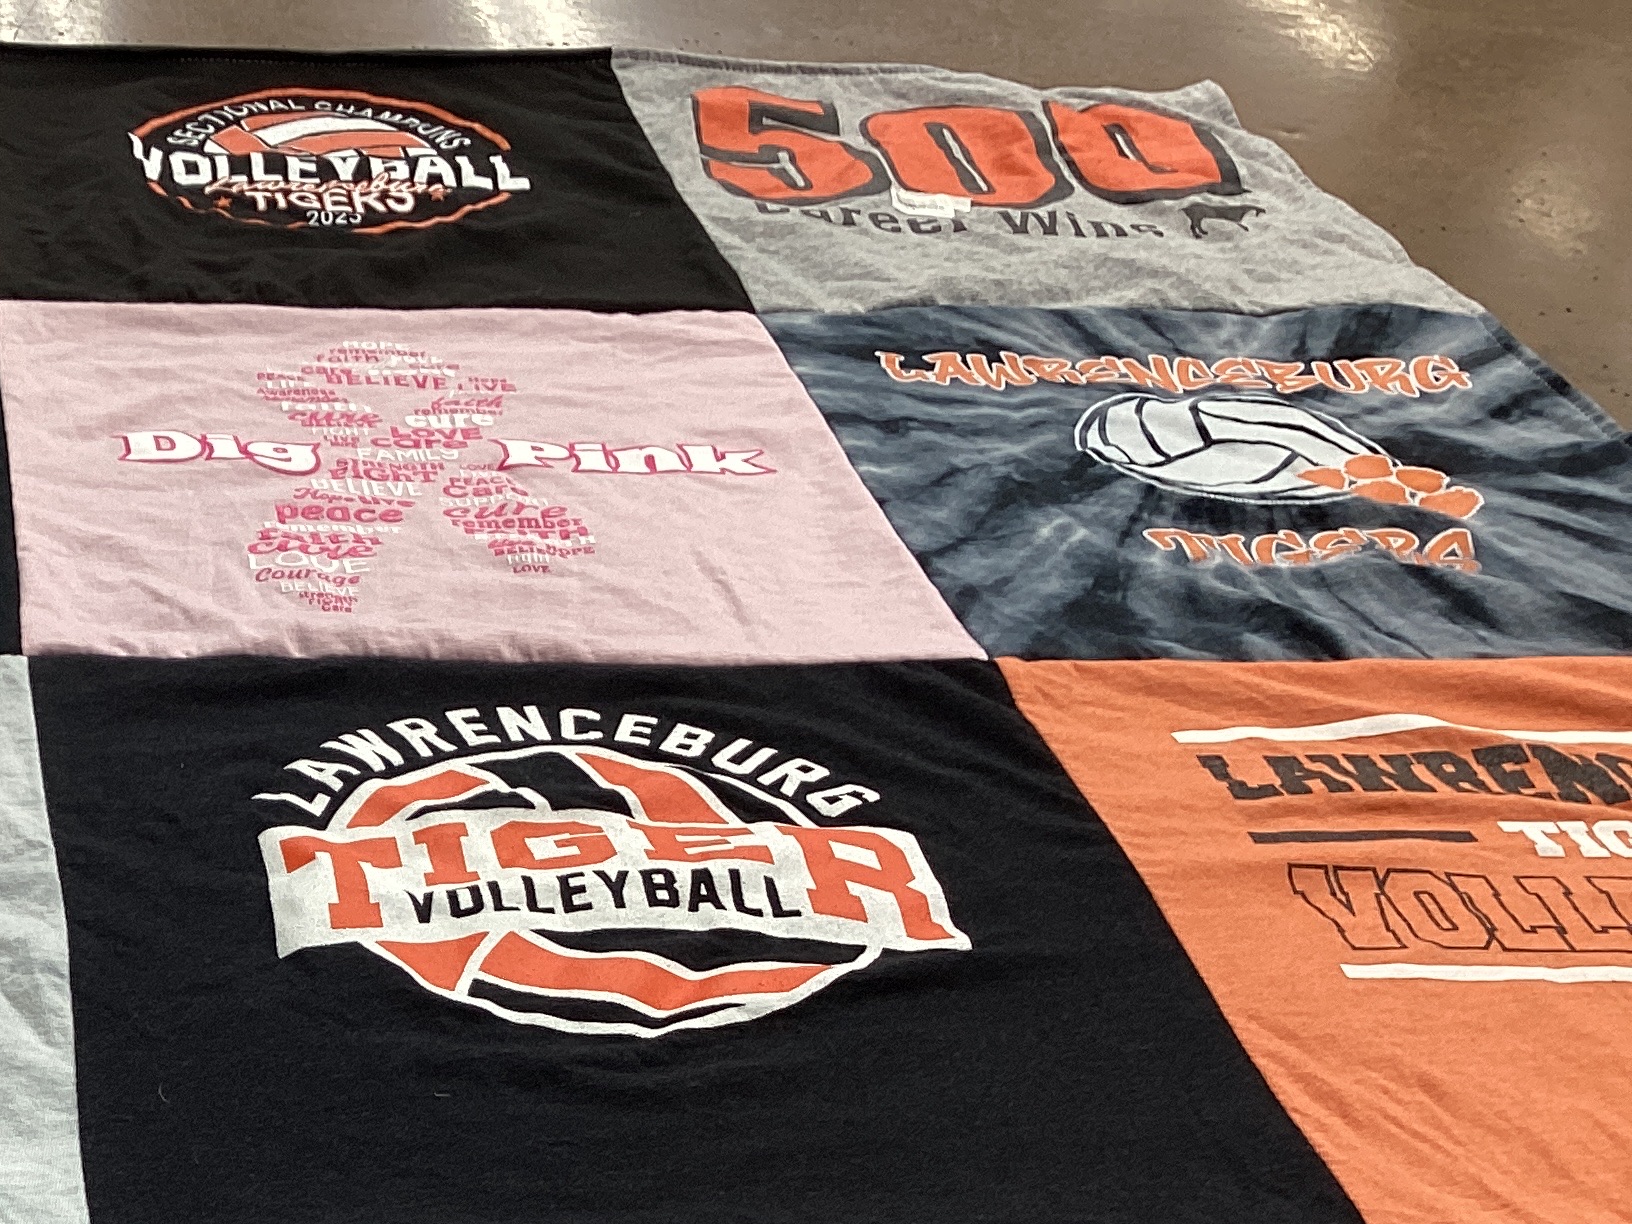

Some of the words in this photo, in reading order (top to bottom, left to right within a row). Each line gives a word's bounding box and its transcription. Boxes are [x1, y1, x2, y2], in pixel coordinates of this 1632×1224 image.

[167, 98, 306, 147] SECTIONAL
[128, 132, 531, 191] VOLLEYBALL
[690, 86, 1252, 210] 500
[875, 350, 1472, 396] LAWRENCEBURG
[113, 430, 321, 476] Dig
[390, 425, 484, 441] LOVE
[489, 438, 778, 476] Pink
[275, 503, 405, 525] peace
[255, 567, 361, 587] Courage
[251, 705, 882, 817] LAWRENCEBURG
[278, 820, 964, 942] TIGER
[405, 866, 803, 924] VOLLEYBALL
